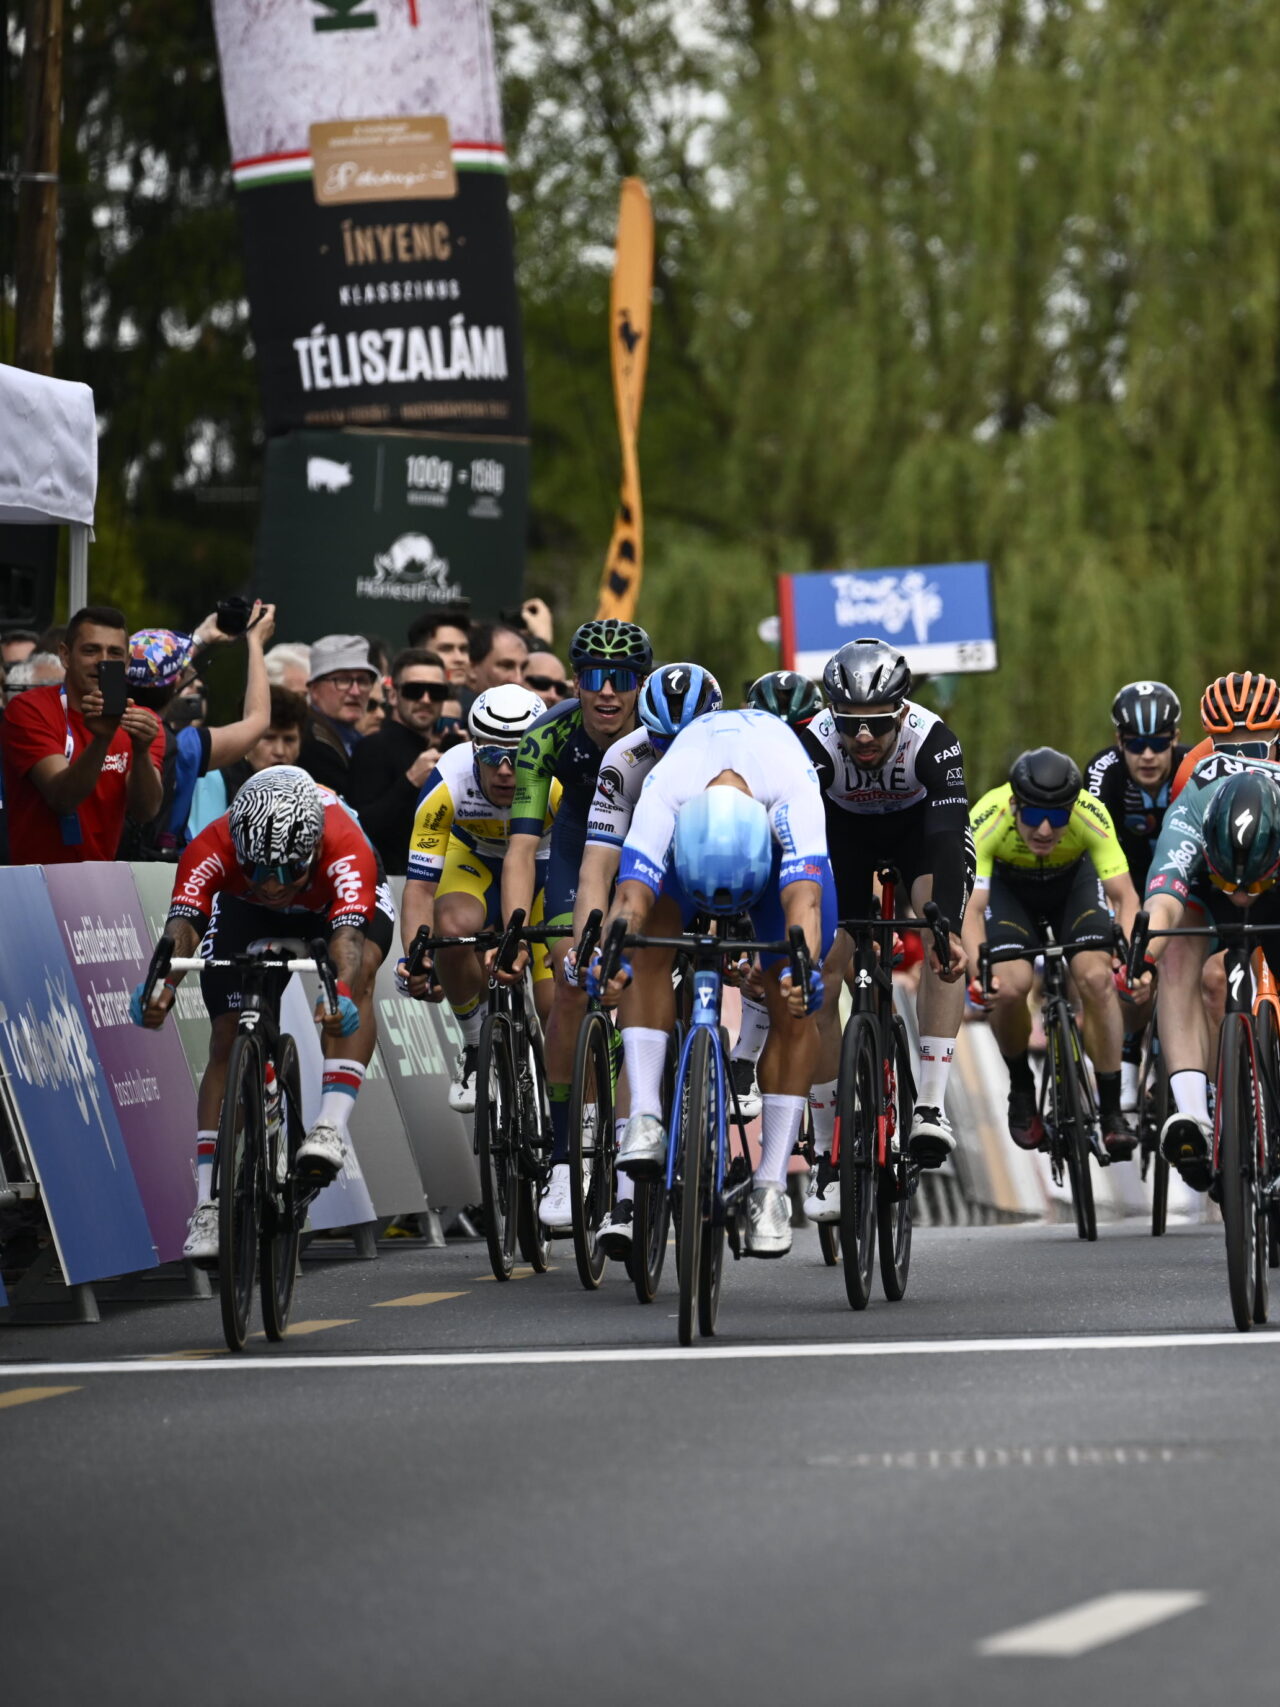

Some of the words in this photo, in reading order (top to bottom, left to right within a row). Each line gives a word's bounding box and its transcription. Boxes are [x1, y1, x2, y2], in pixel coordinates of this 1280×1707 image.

[1088, 750, 1120, 798] oufone
[183, 852, 226, 897] dstny
[326, 854, 364, 904] lotto
